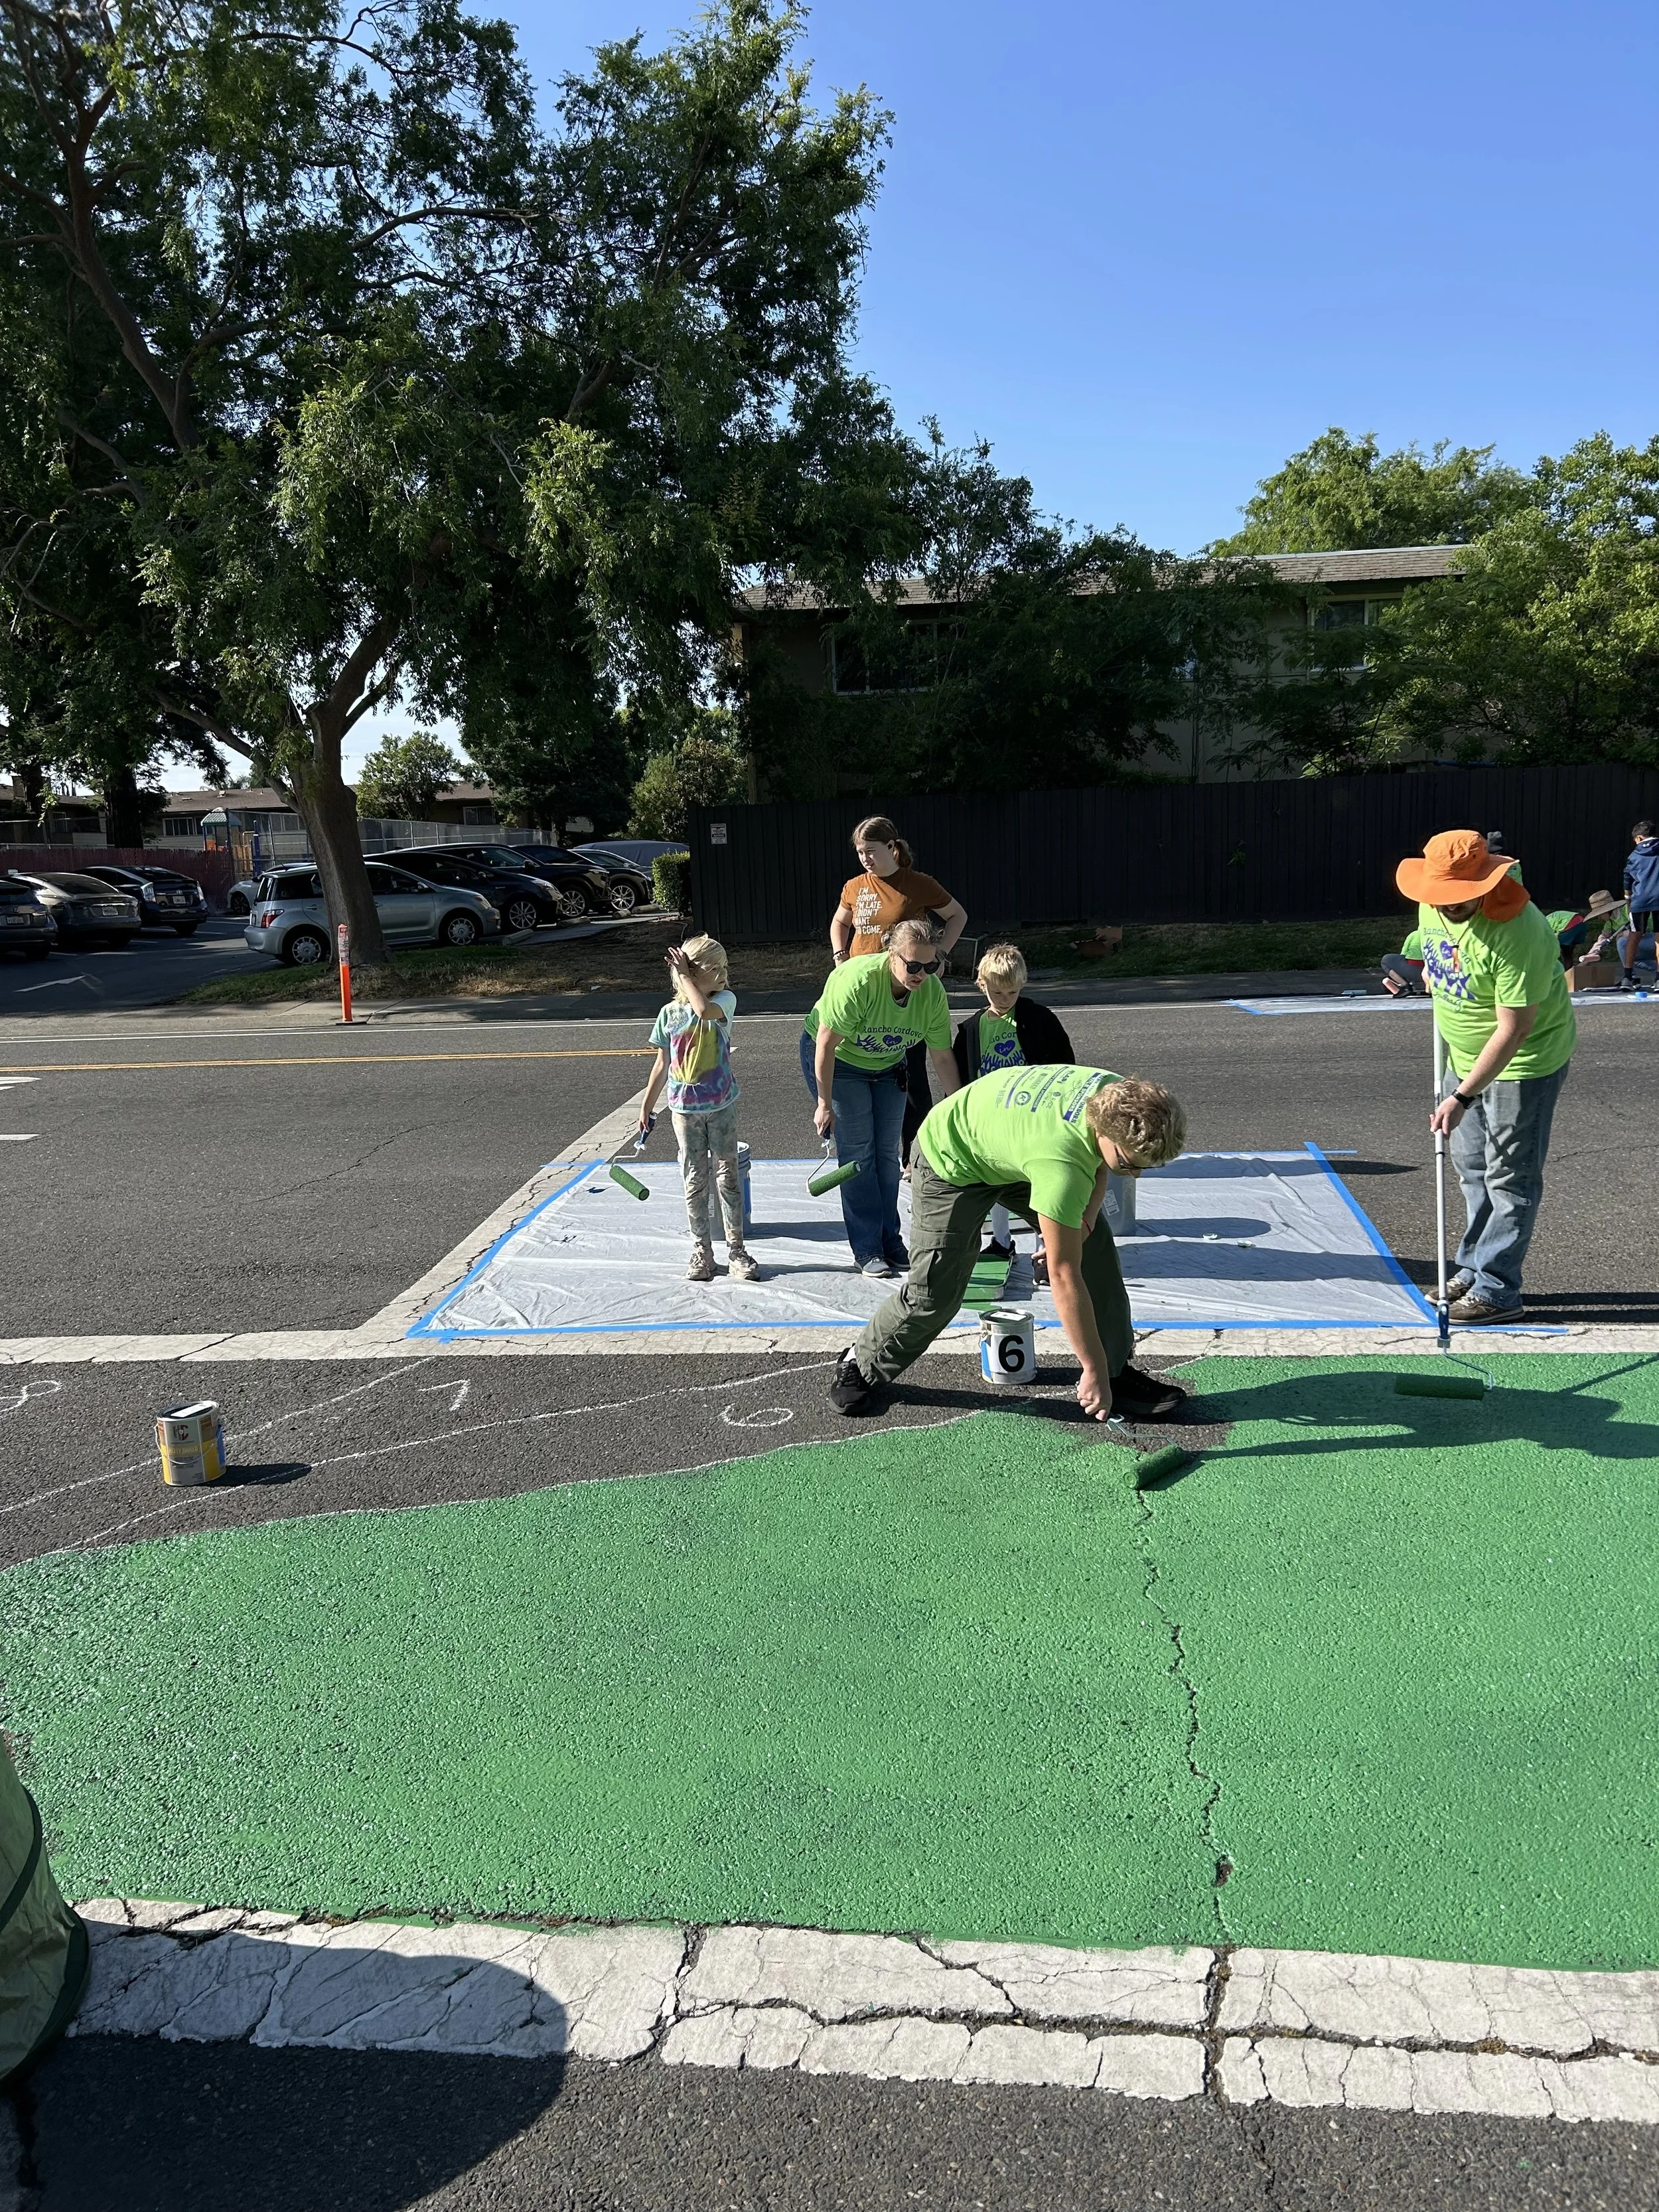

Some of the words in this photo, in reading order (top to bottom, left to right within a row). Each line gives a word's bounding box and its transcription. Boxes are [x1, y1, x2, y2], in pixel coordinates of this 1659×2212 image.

[859, 887, 869, 895] I'M
[856, 893, 878, 902] SORRY
[857, 909, 879, 917] DIDN'T
[854, 917, 871, 926] WANT
[862, 924, 883, 934] COME.
[863, 1025, 892, 1033] Rancho
[1068, 1088, 1088, 1112] SPONSORS
[998, 1335, 1025, 1372] 6
[417, 1378, 471, 1412] 7
[719, 1402, 794, 1428] 6
